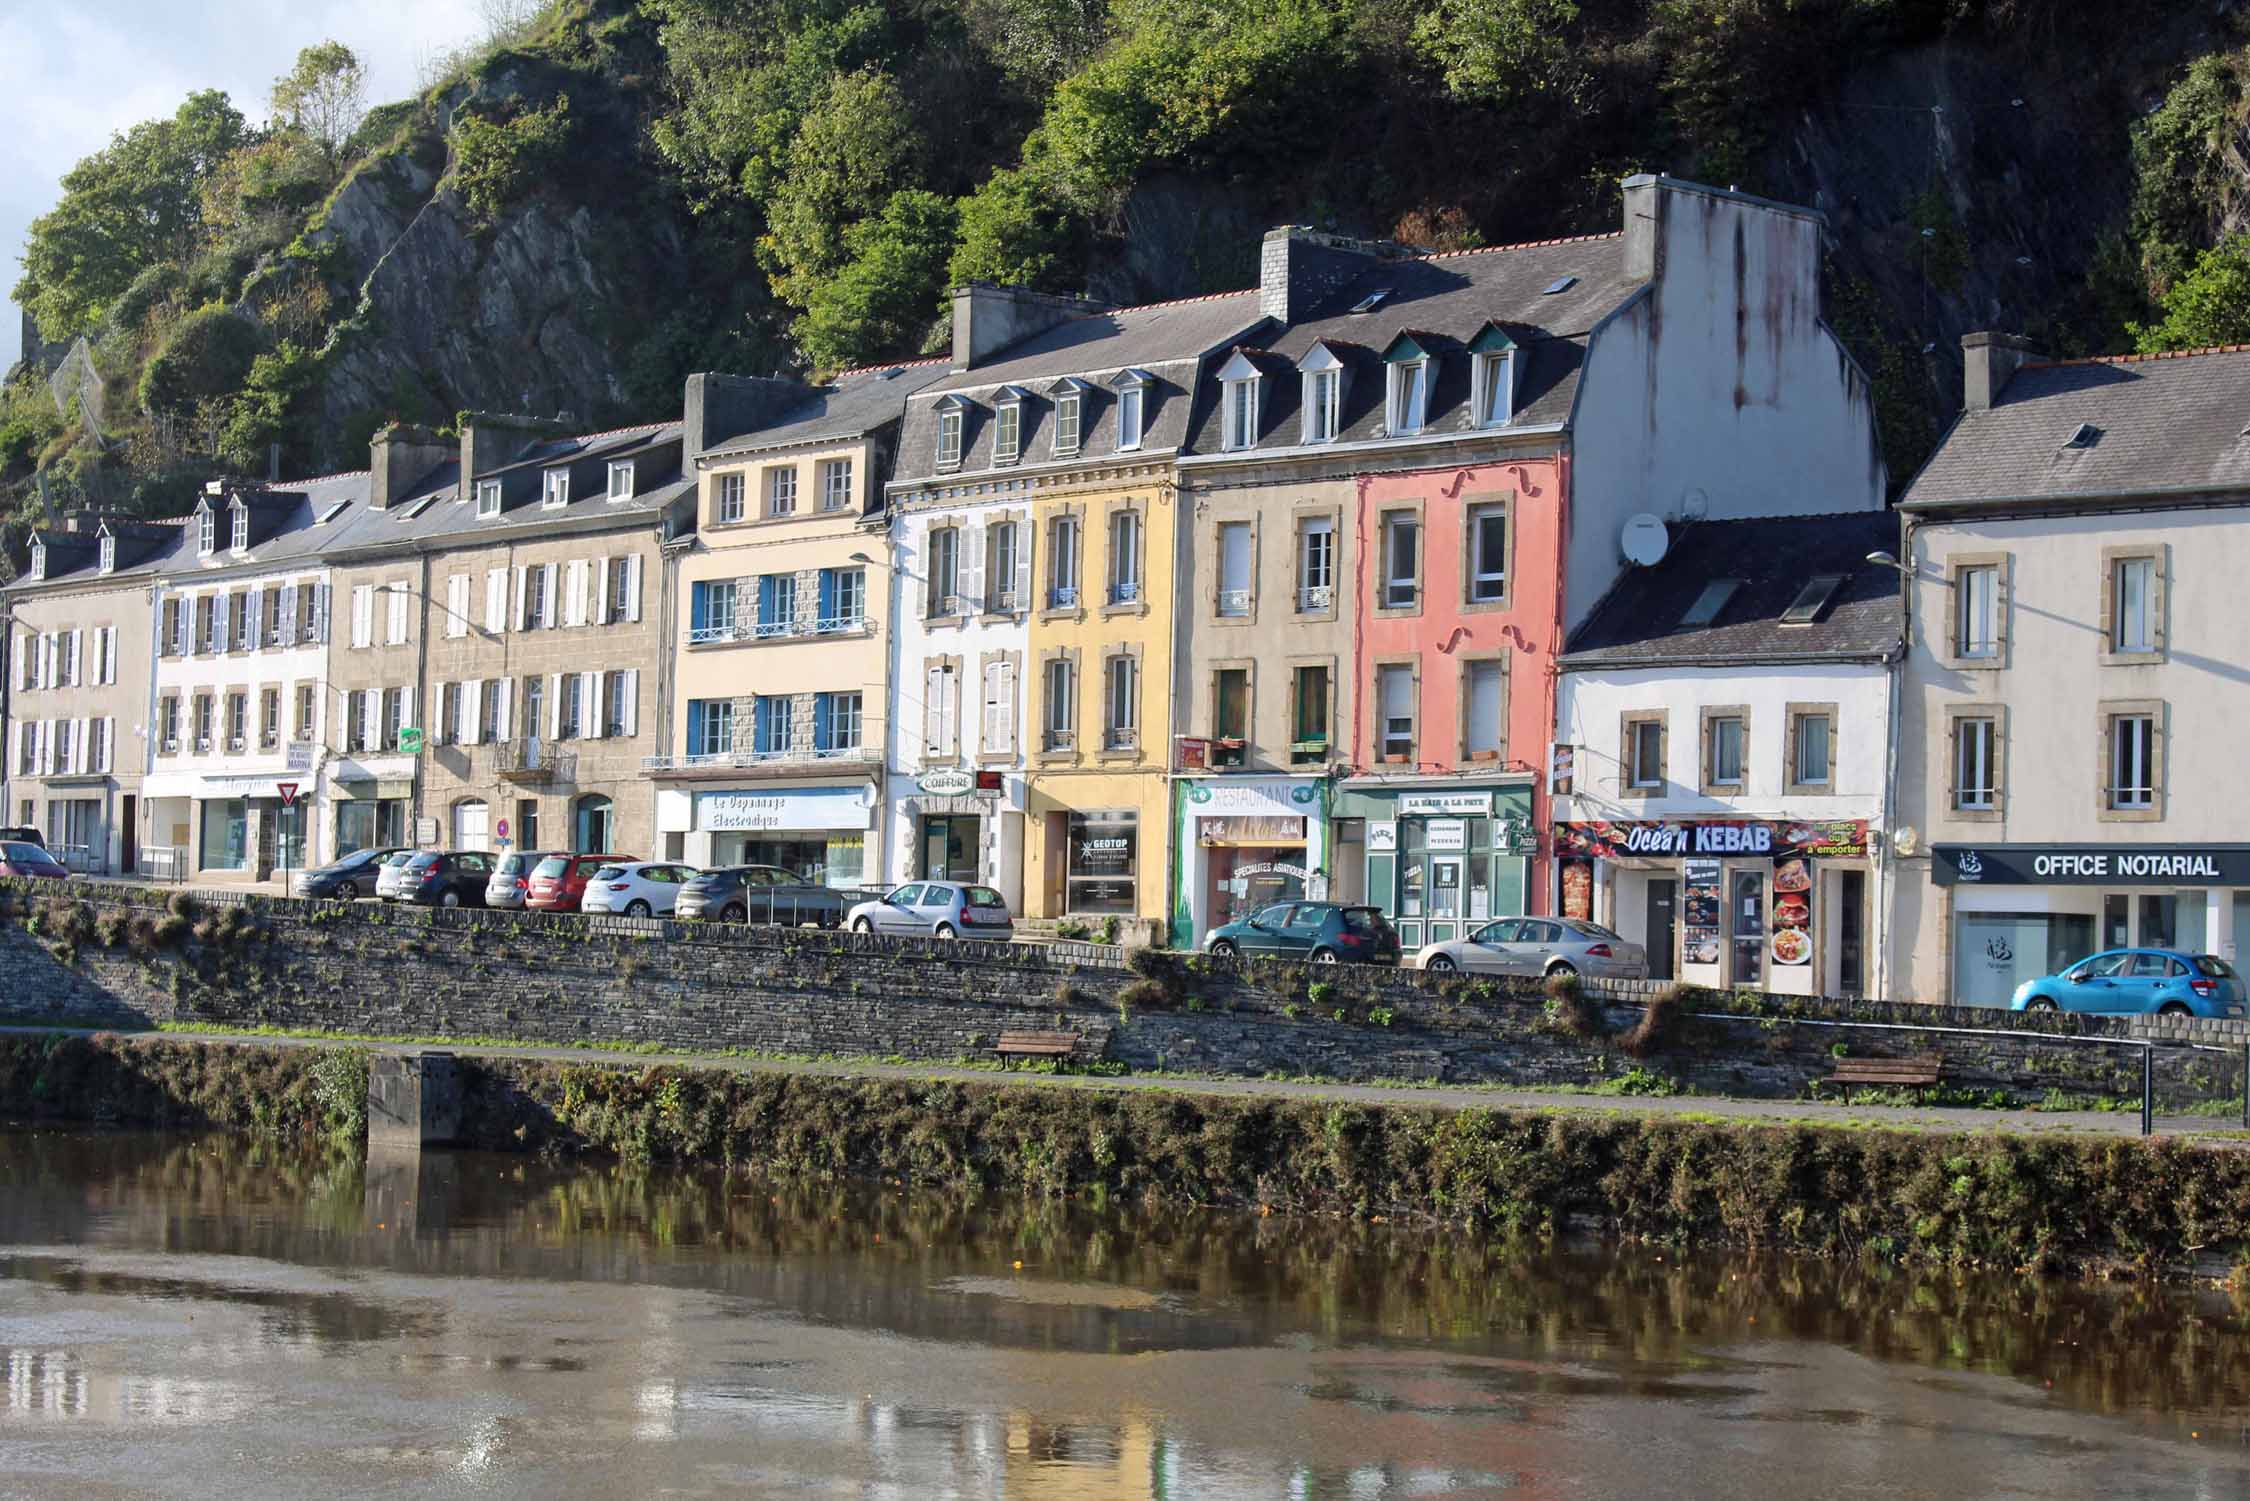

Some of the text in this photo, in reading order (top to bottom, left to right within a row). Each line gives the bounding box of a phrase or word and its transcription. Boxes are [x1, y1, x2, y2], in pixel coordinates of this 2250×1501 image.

[288, 760, 311, 769] MARINA
[925, 776, 969, 788] COIFFURE
[714, 796, 725, 809] Le
[1213, 784, 1291, 808] RESTAURANT
[1371, 829, 1394, 843] PIZZA
[1520, 837, 1537, 847] PIZZA
[1695, 826, 1770, 851] KEBAB
[1093, 839, 1128, 848] GEOTOP
[1817, 846, 1861, 855] emporter
[1404, 865, 1422, 879] PIZZA
[2034, 855, 2220, 876] OFFICE NOTARIAL
